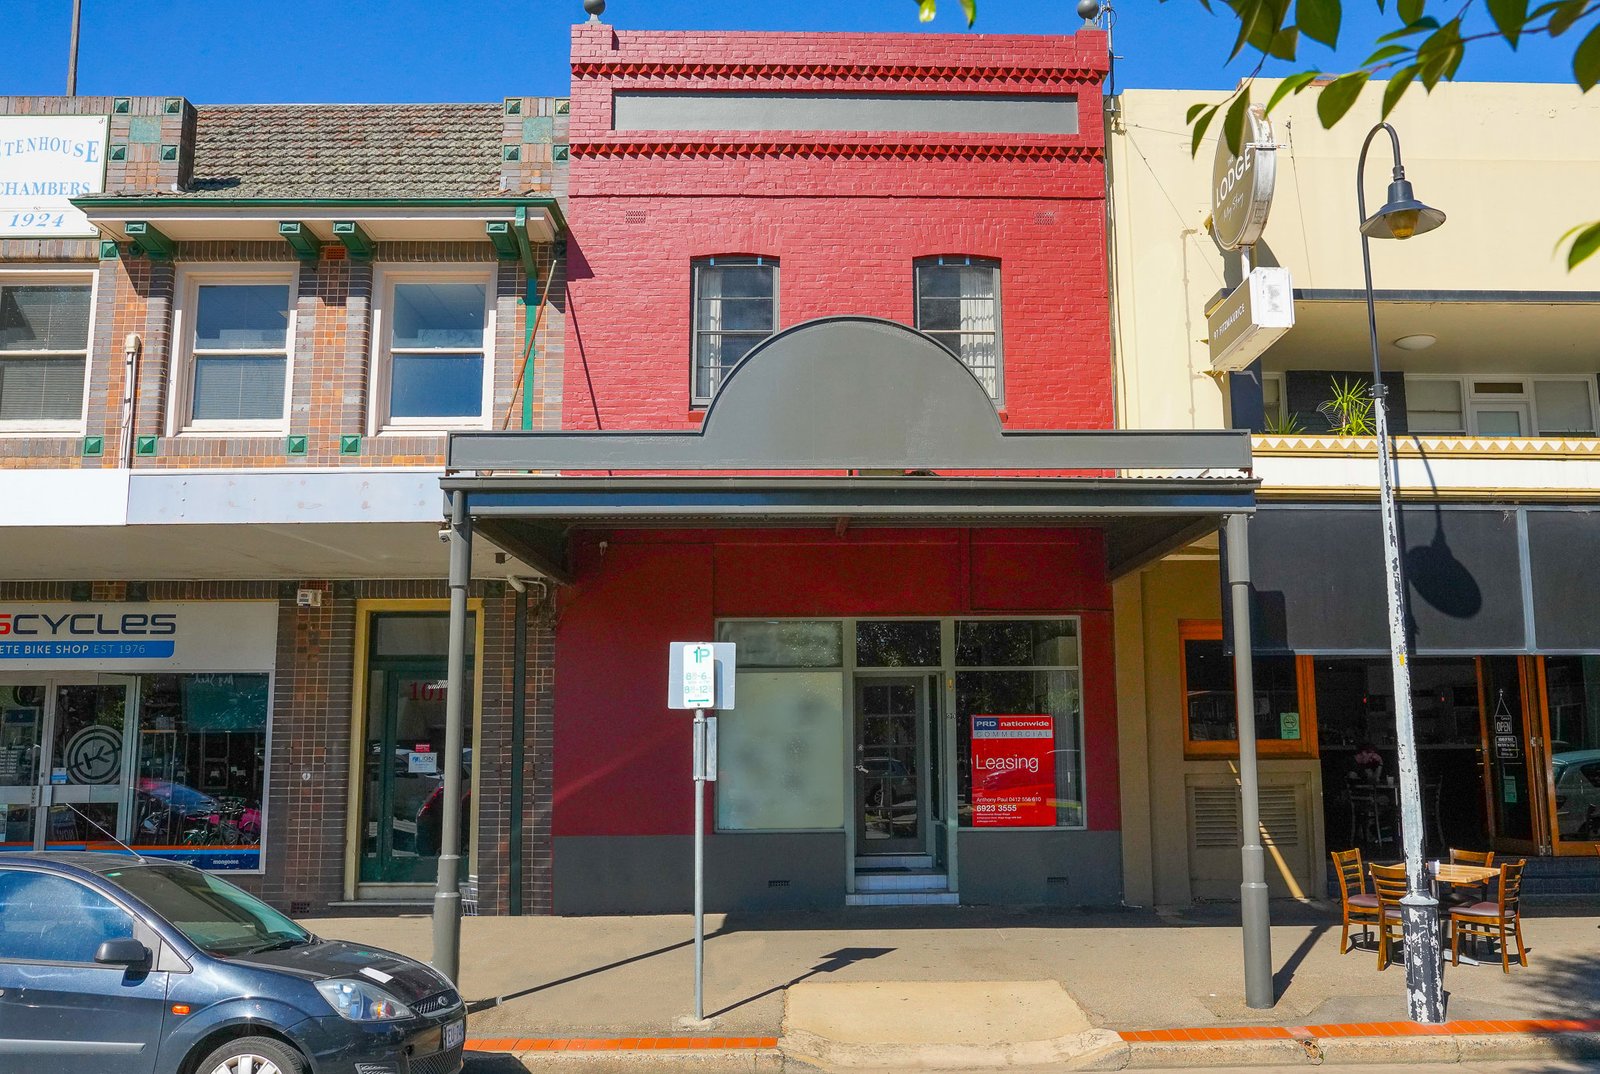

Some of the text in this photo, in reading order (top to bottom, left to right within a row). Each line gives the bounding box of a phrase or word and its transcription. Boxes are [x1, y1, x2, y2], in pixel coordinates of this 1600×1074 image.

[0, 136, 100, 163] TENHOUSE
[1216, 147, 1251, 209] LODGE
[9, 211, 65, 228] 1924
[24, 645, 52, 655] BIKE
[55, 644, 89, 655] SHOP
[94, 645, 113, 654] EST
[119, 645, 146, 654] 1976
[693, 648, 711, 664] 1P
[1496, 721, 1511, 731] OPEN
[975, 754, 1039, 773] Leasing
[976, 804, 1017, 812] 6923 3555
